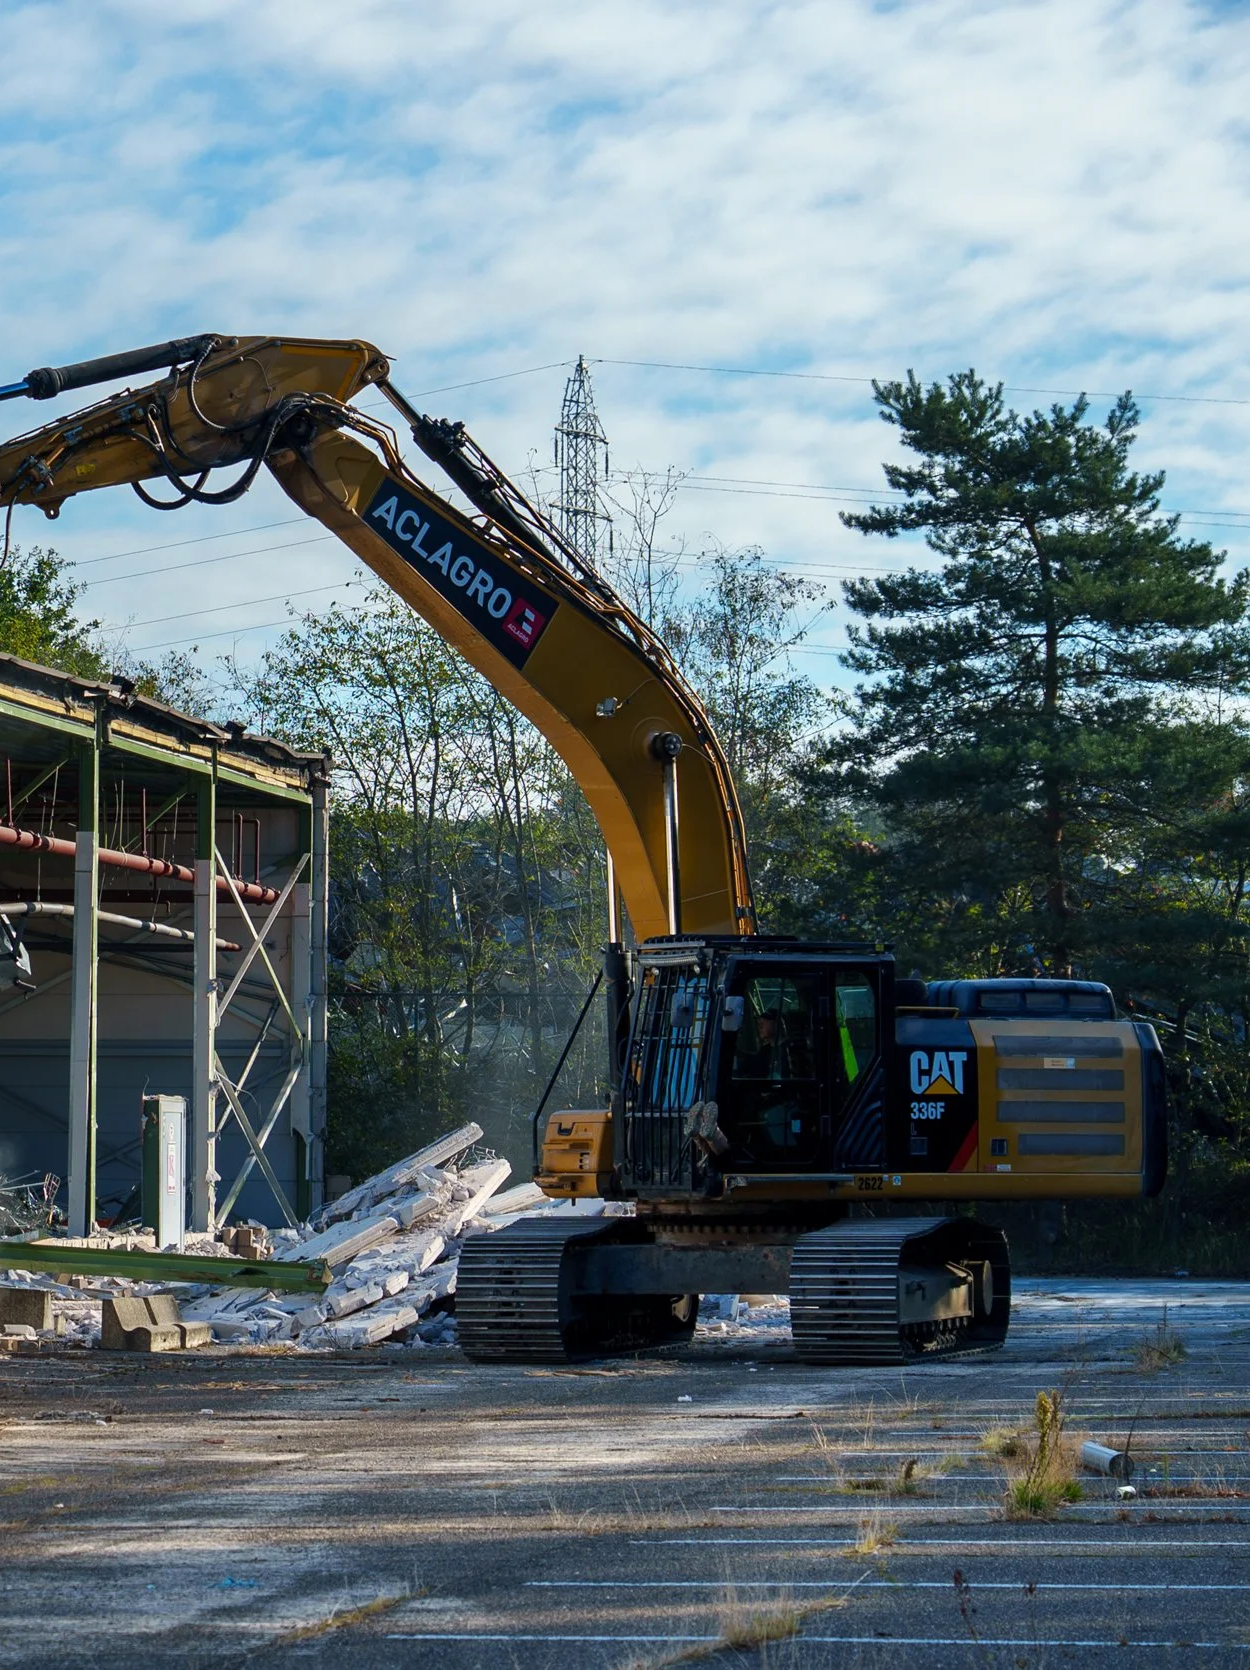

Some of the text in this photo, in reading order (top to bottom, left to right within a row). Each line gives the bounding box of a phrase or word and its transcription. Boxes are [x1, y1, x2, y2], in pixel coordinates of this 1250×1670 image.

[372, 496, 511, 619] ACLAGRO
[507, 623, 529, 643] ACLAGRO
[910, 1051, 967, 1095] CAT
[910, 1102, 945, 1119] 336F
[858, 1177, 883, 1191] 2622
